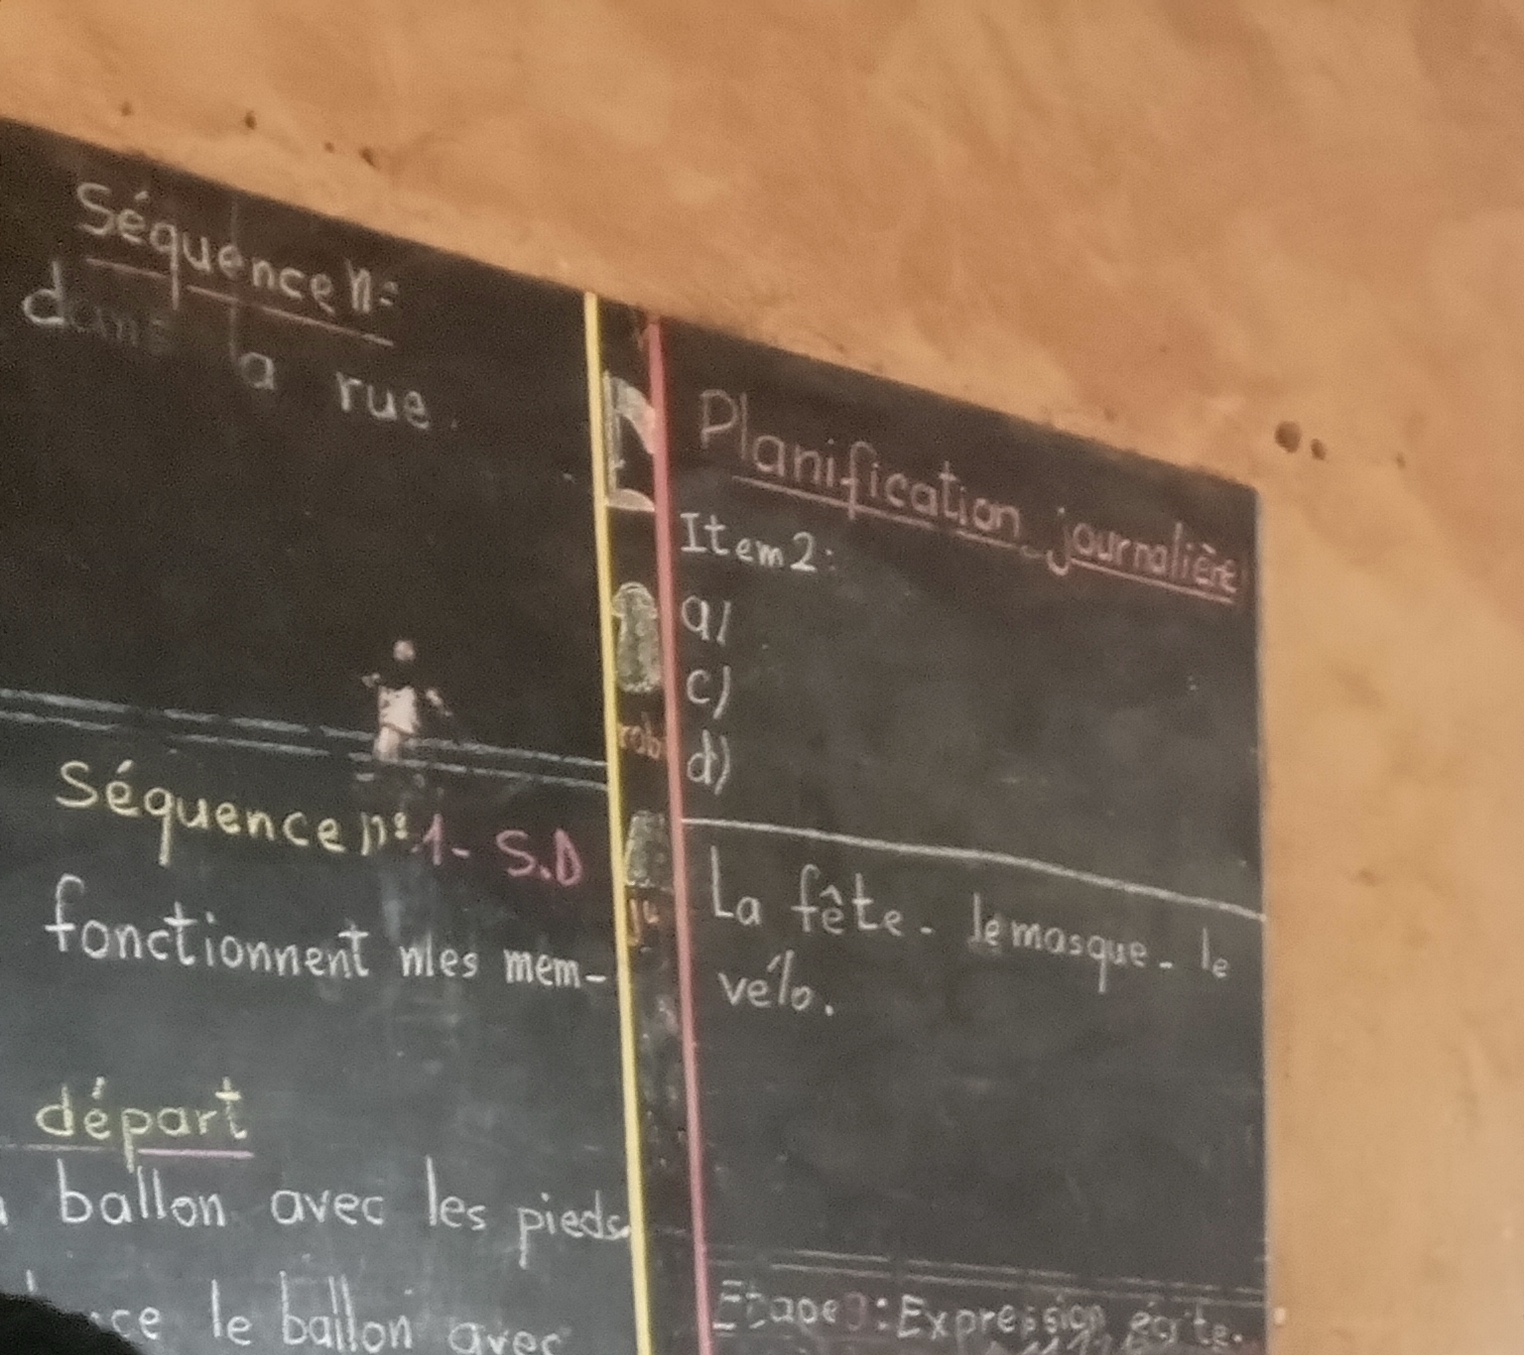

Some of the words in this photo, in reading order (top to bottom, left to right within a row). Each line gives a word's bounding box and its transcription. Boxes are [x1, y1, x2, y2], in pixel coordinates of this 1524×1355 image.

[76, 182, 337, 314] Séquence
[699, 389, 1020, 540] Planification
[55, 759, 346, 865] Séquence
[44, 873, 369, 978] fonctionnent
[710, 846, 762, 924] La
[1201, 927, 1230, 978] le
[35, 1077, 248, 1172] départ
[57, 1158, 226, 1228] ballon
[271, 1187, 385, 1227] avec
[425, 1155, 487, 1232] les
[211, 1278, 253, 1346] le
[280, 1270, 412, 1353] ballon
